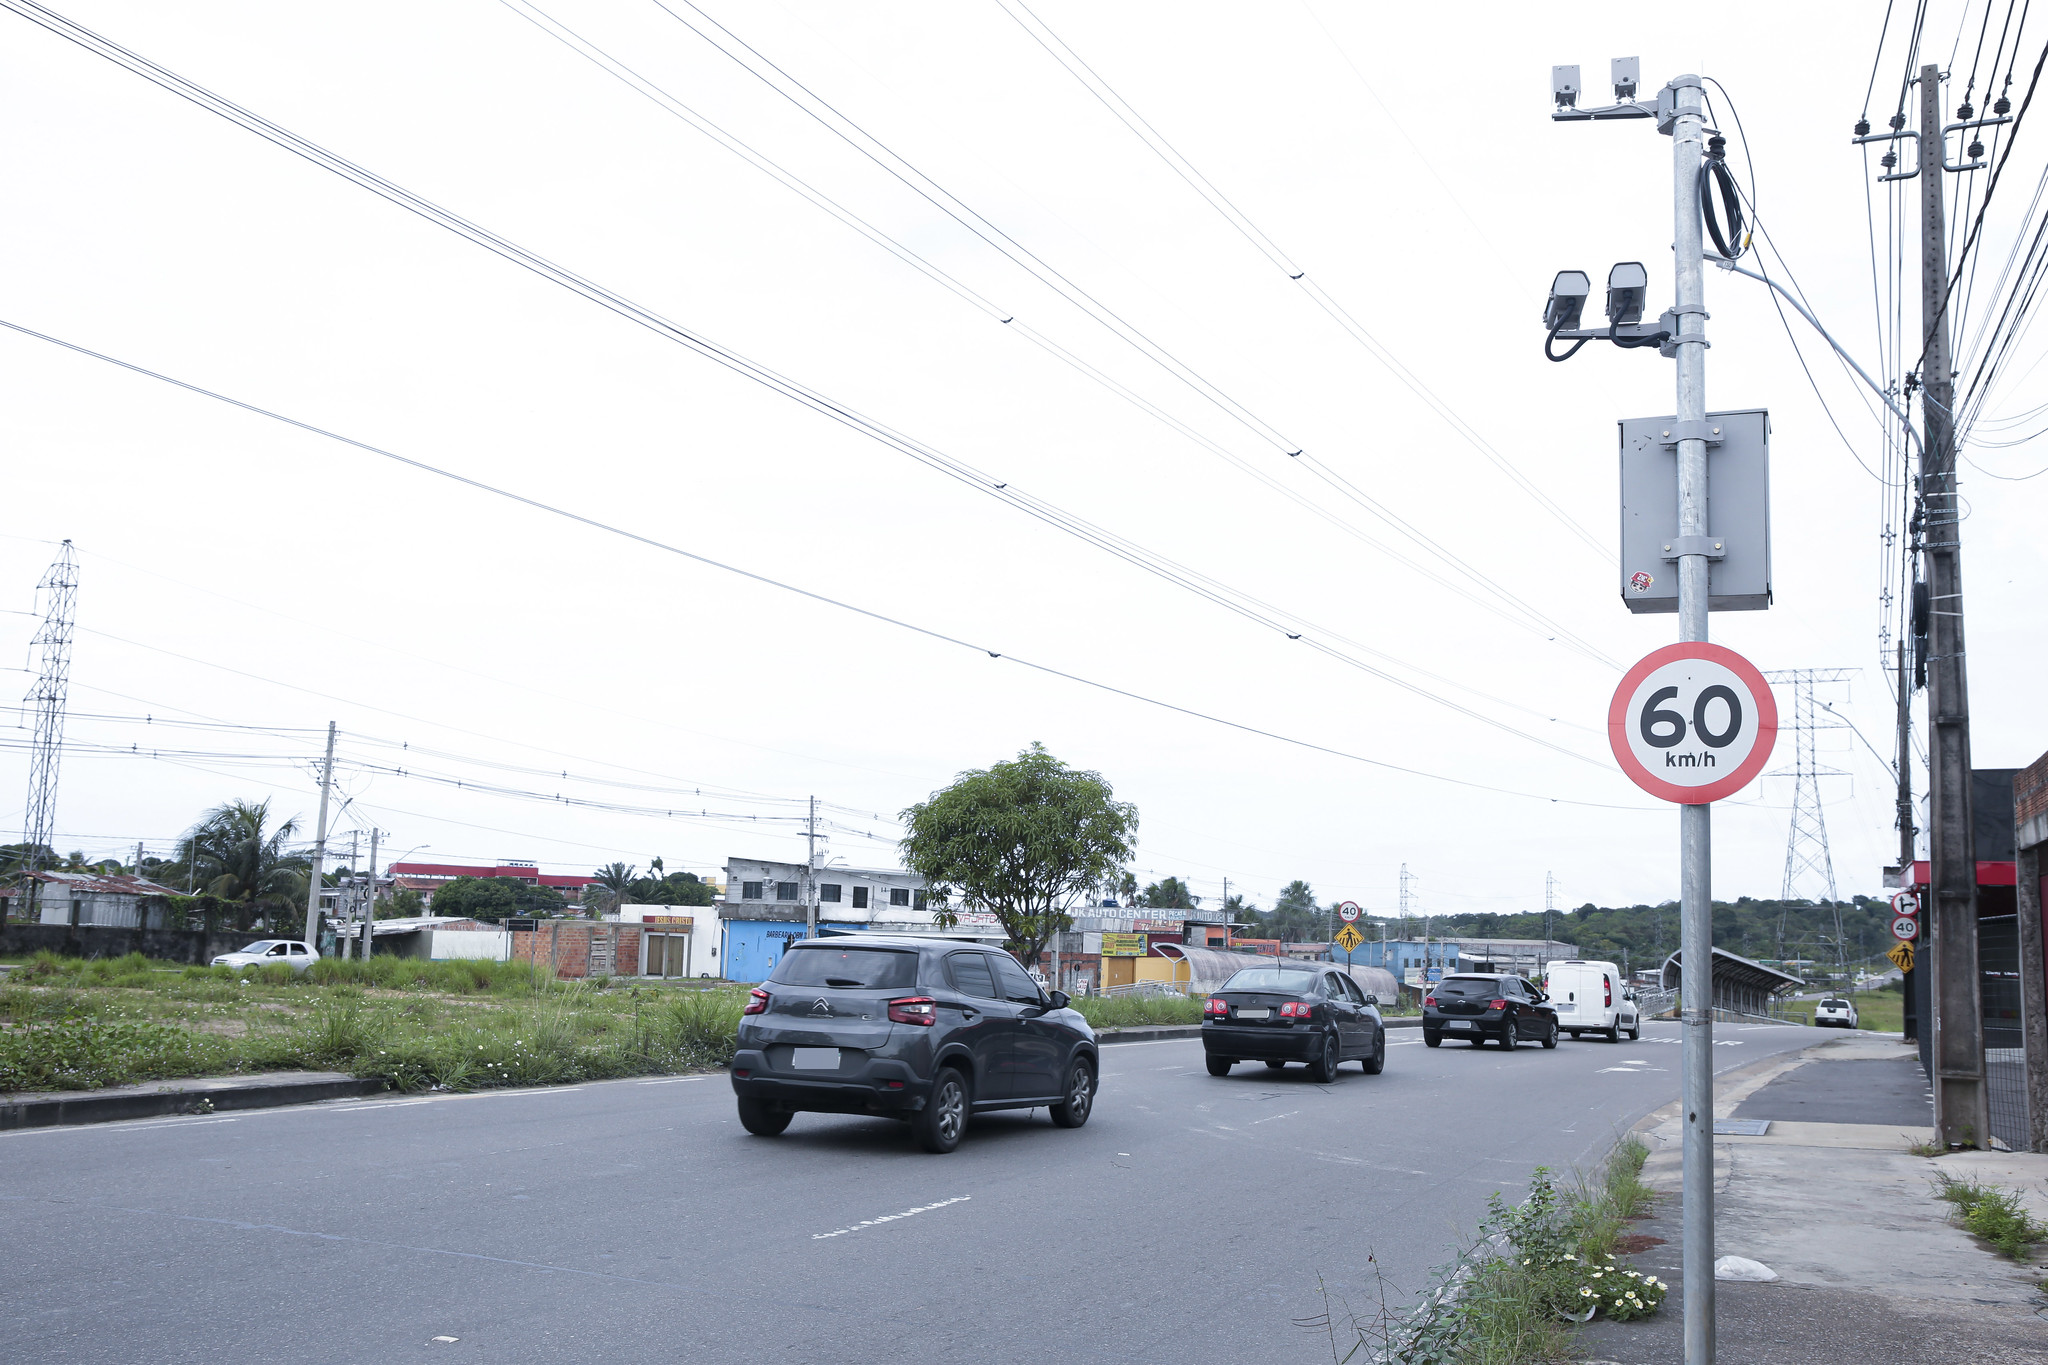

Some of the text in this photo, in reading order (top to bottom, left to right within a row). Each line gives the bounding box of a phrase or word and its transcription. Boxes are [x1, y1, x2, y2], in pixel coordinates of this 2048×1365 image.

[1640, 684, 1743, 749] 60
[1665, 751, 1716, 767] km/h
[1071, 909, 1086, 917] JK
[1088, 910, 1117, 918] AUTO
[1118, 910, 1167, 919] CENTER
[1342, 907, 1356, 916] 40
[1896, 923, 1914, 932] 40
